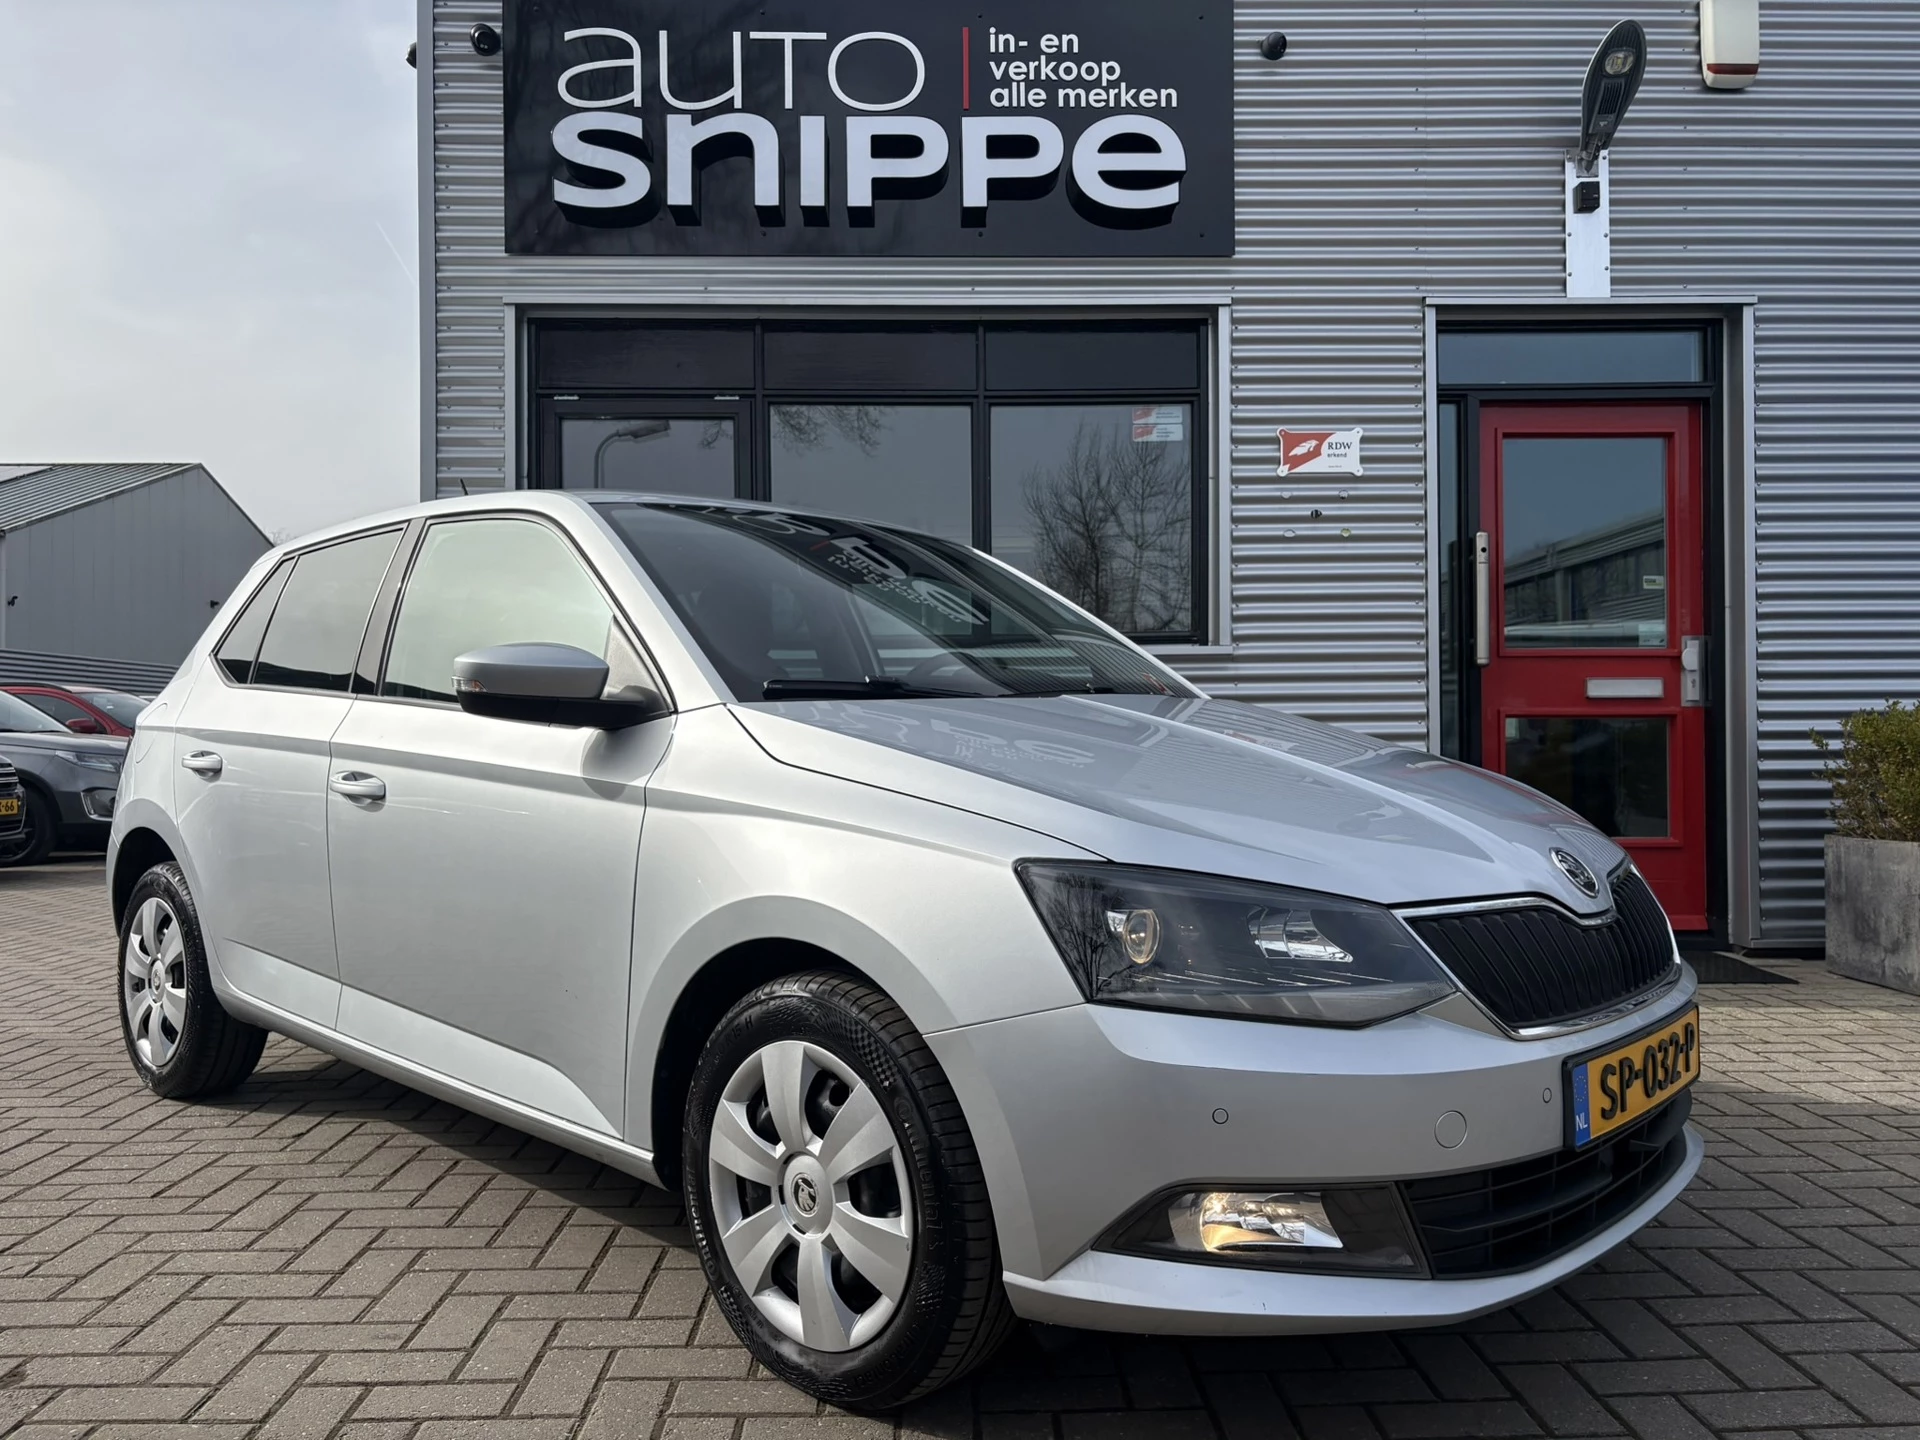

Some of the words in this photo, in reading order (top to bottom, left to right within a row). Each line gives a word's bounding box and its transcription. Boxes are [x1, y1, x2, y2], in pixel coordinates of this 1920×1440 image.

[989, 27, 1029, 54] in-
[1040, 32, 1080, 54] en
[989, 57, 1121, 86] verkoop
[989, 83, 1047, 108] alle
[1058, 83, 1178, 108] merken
[1327, 441, 1353, 450] RDW
[1600, 1022, 1695, 1120] SP-032-P
[1575, 1115, 1588, 1131] NL
